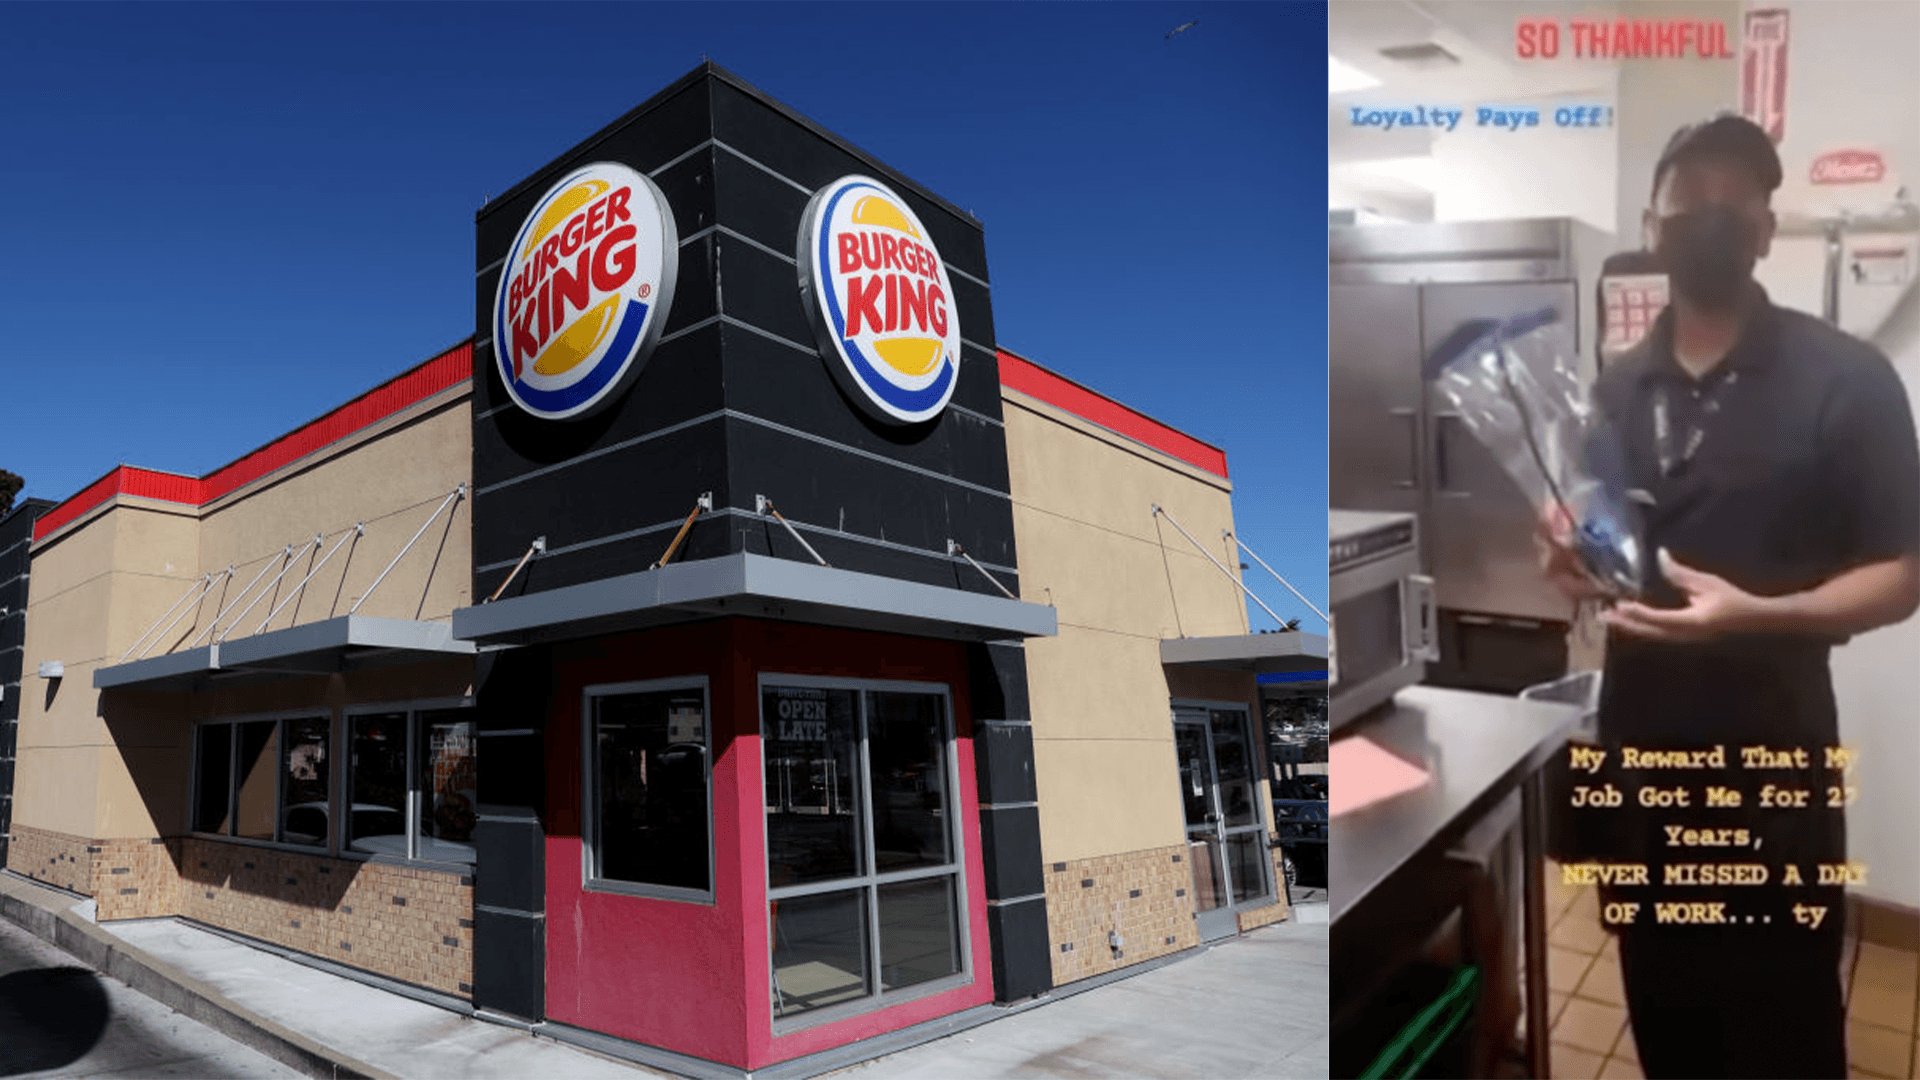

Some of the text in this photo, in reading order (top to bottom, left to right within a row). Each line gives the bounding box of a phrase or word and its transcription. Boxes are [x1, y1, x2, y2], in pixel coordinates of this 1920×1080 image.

[508, 185, 632, 321] BURGER
[838, 232, 941, 284] BURGER
[509, 224, 637, 382] KING
[844, 273, 949, 340] KING
[777, 699, 826, 719] OPEN
[777, 720, 827, 741] LATE
